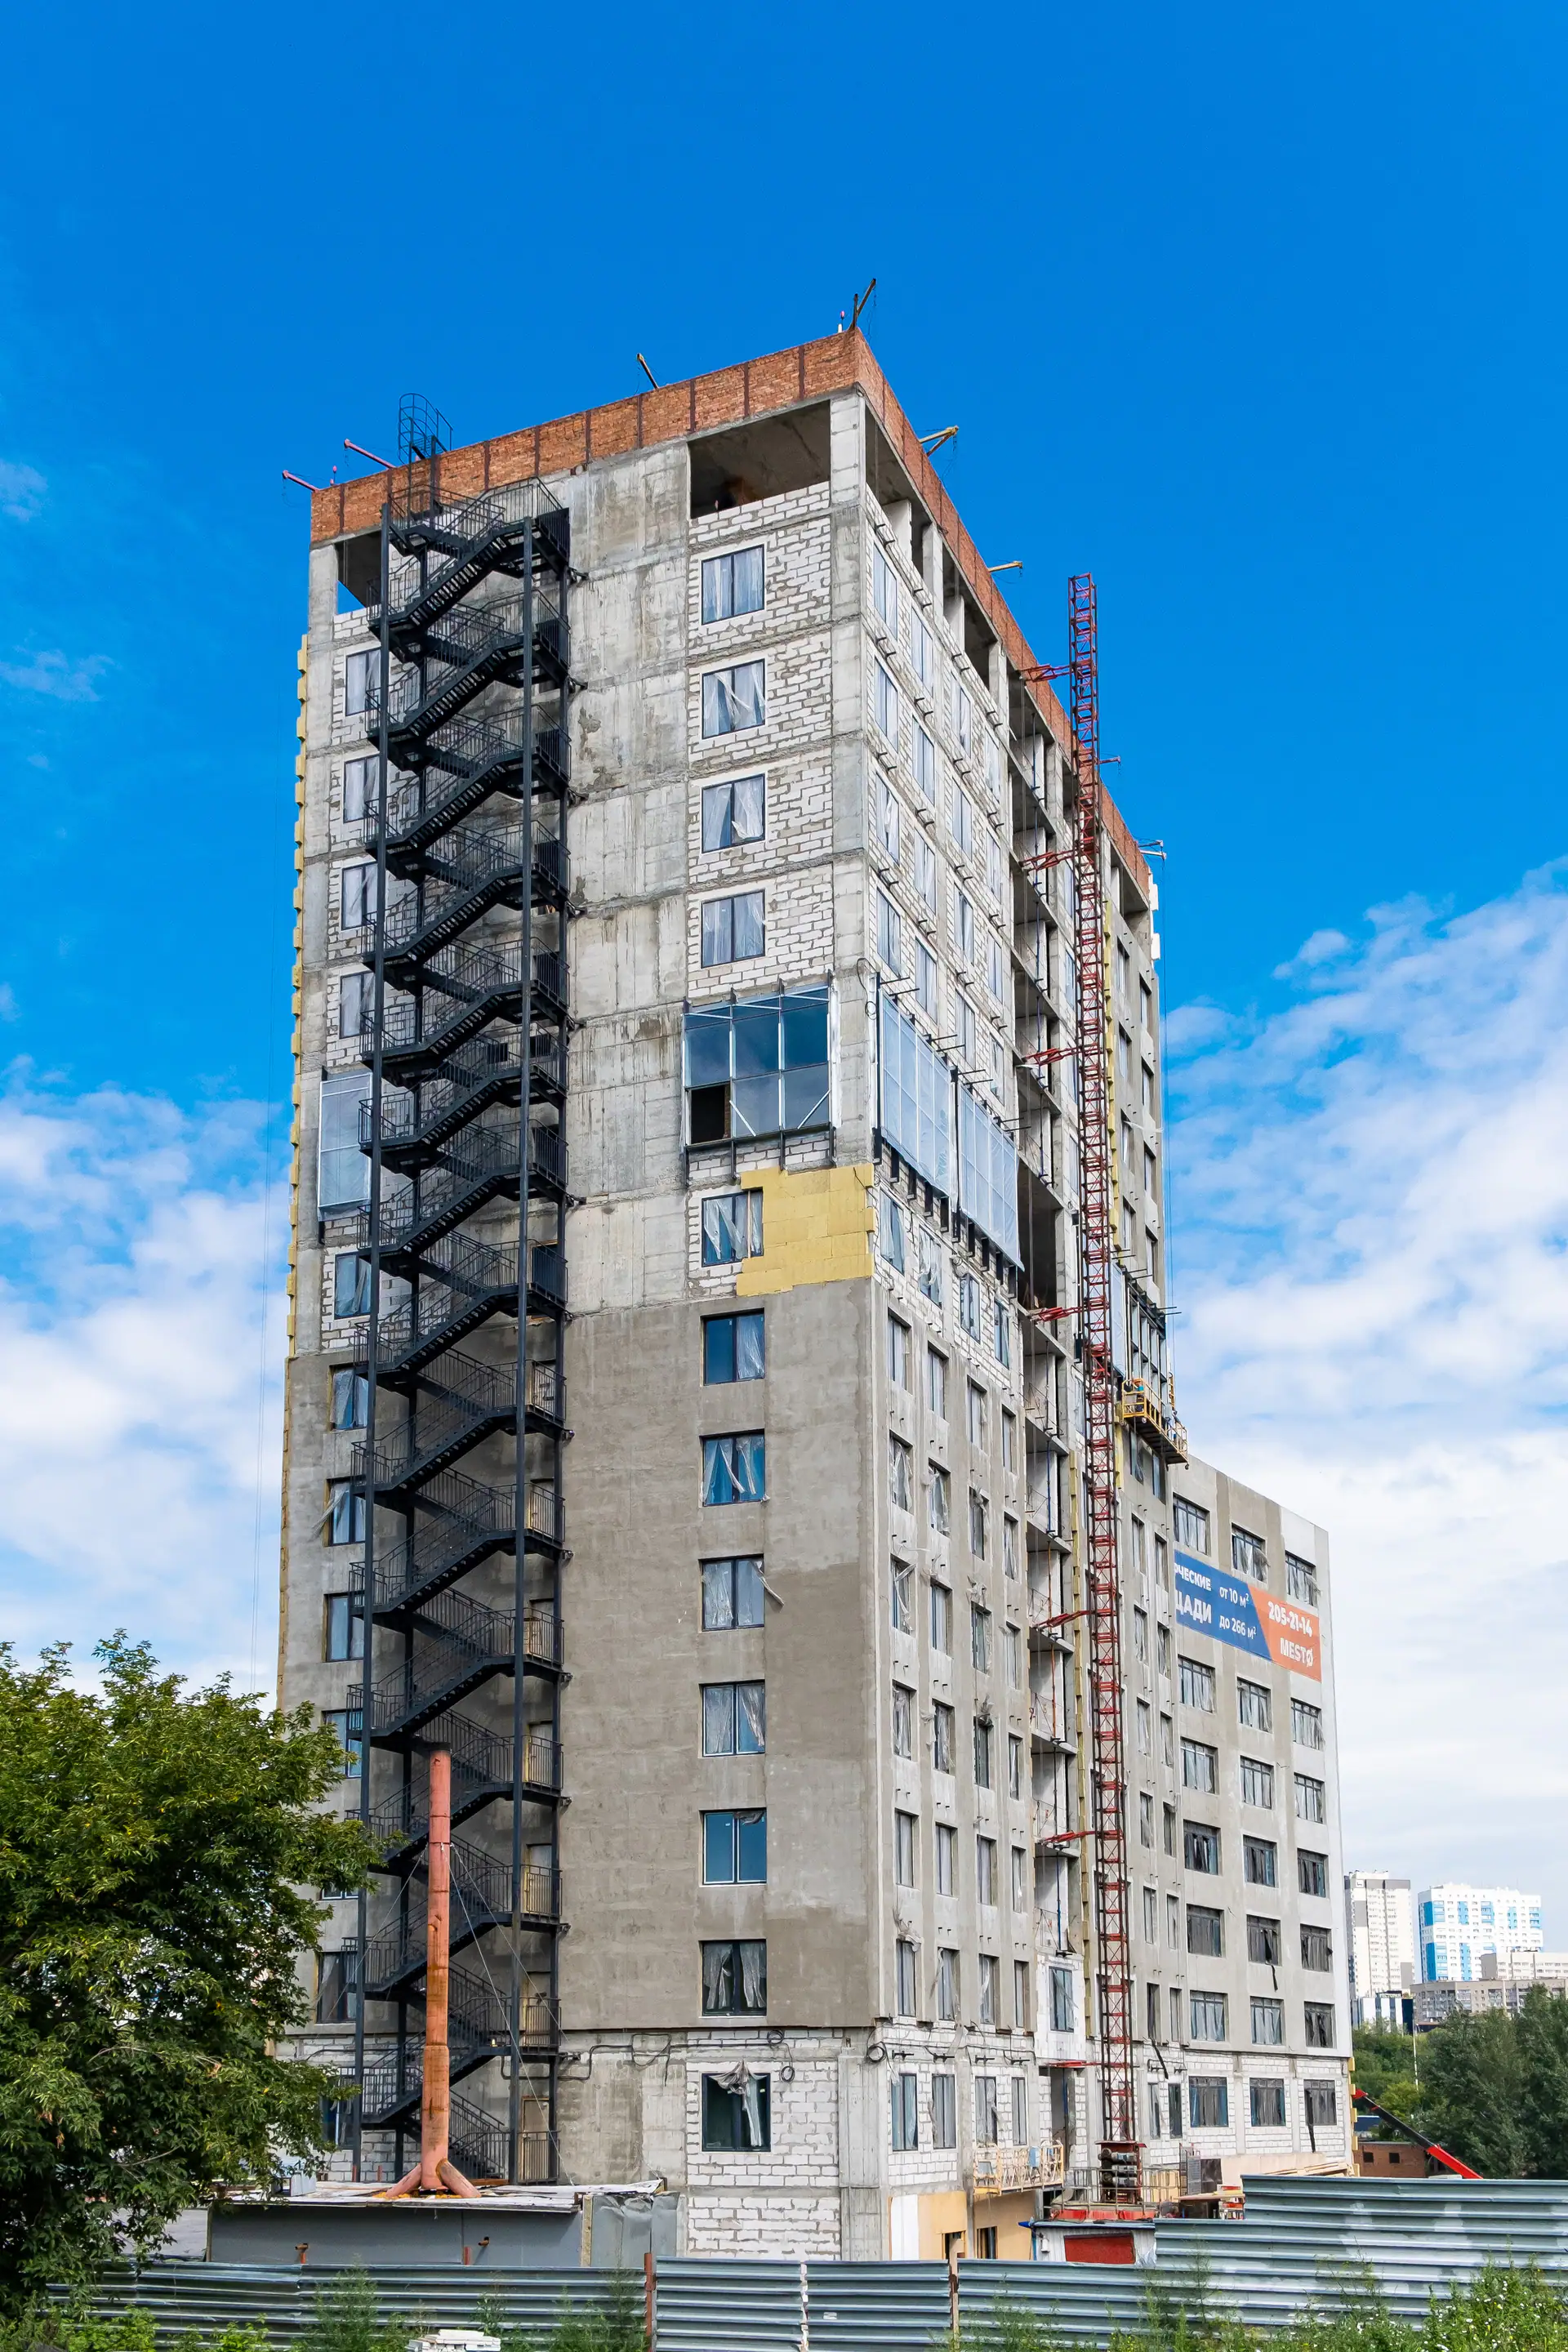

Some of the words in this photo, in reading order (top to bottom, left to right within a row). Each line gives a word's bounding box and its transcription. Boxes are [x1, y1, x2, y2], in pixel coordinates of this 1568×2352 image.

[1219, 1586, 1228, 1600] от
[1229, 1588, 1238, 1604] 10
[1219, 1615, 1230, 1629] до
[1232, 1618, 1245, 1637] 266
[1267, 1601, 1313, 1637] 205-21-14
